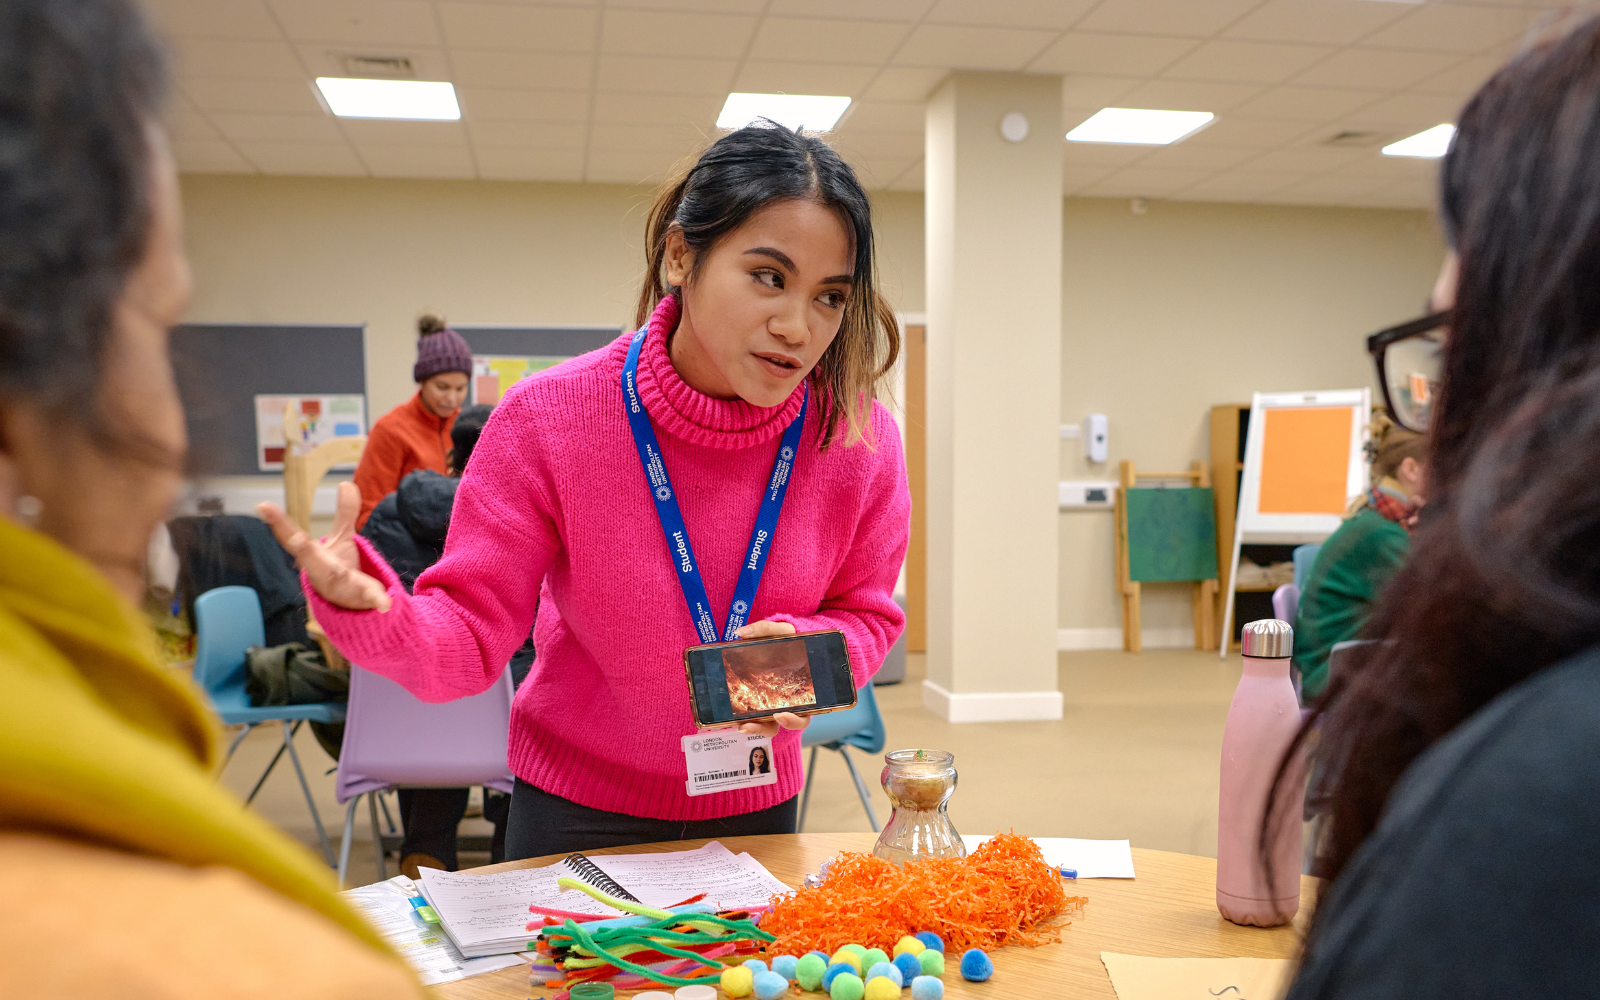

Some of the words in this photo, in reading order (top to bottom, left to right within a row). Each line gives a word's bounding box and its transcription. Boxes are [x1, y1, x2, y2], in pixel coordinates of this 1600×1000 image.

[625, 369, 641, 414] Student
[645, 443, 663, 486] METROPOLITAN
[646, 463, 658, 488] LONDON
[653, 452, 668, 485] UNIVERSITY
[770, 459, 783, 491] UNIVERSITY
[771, 460, 787, 502] METROPOLITAN
[780, 462, 791, 486] LONDON
[672, 530, 693, 573] Student
[747, 529, 768, 571] Student
[697, 620, 709, 644] LONDON
[703, 744, 730, 752] UNIVERSITY
